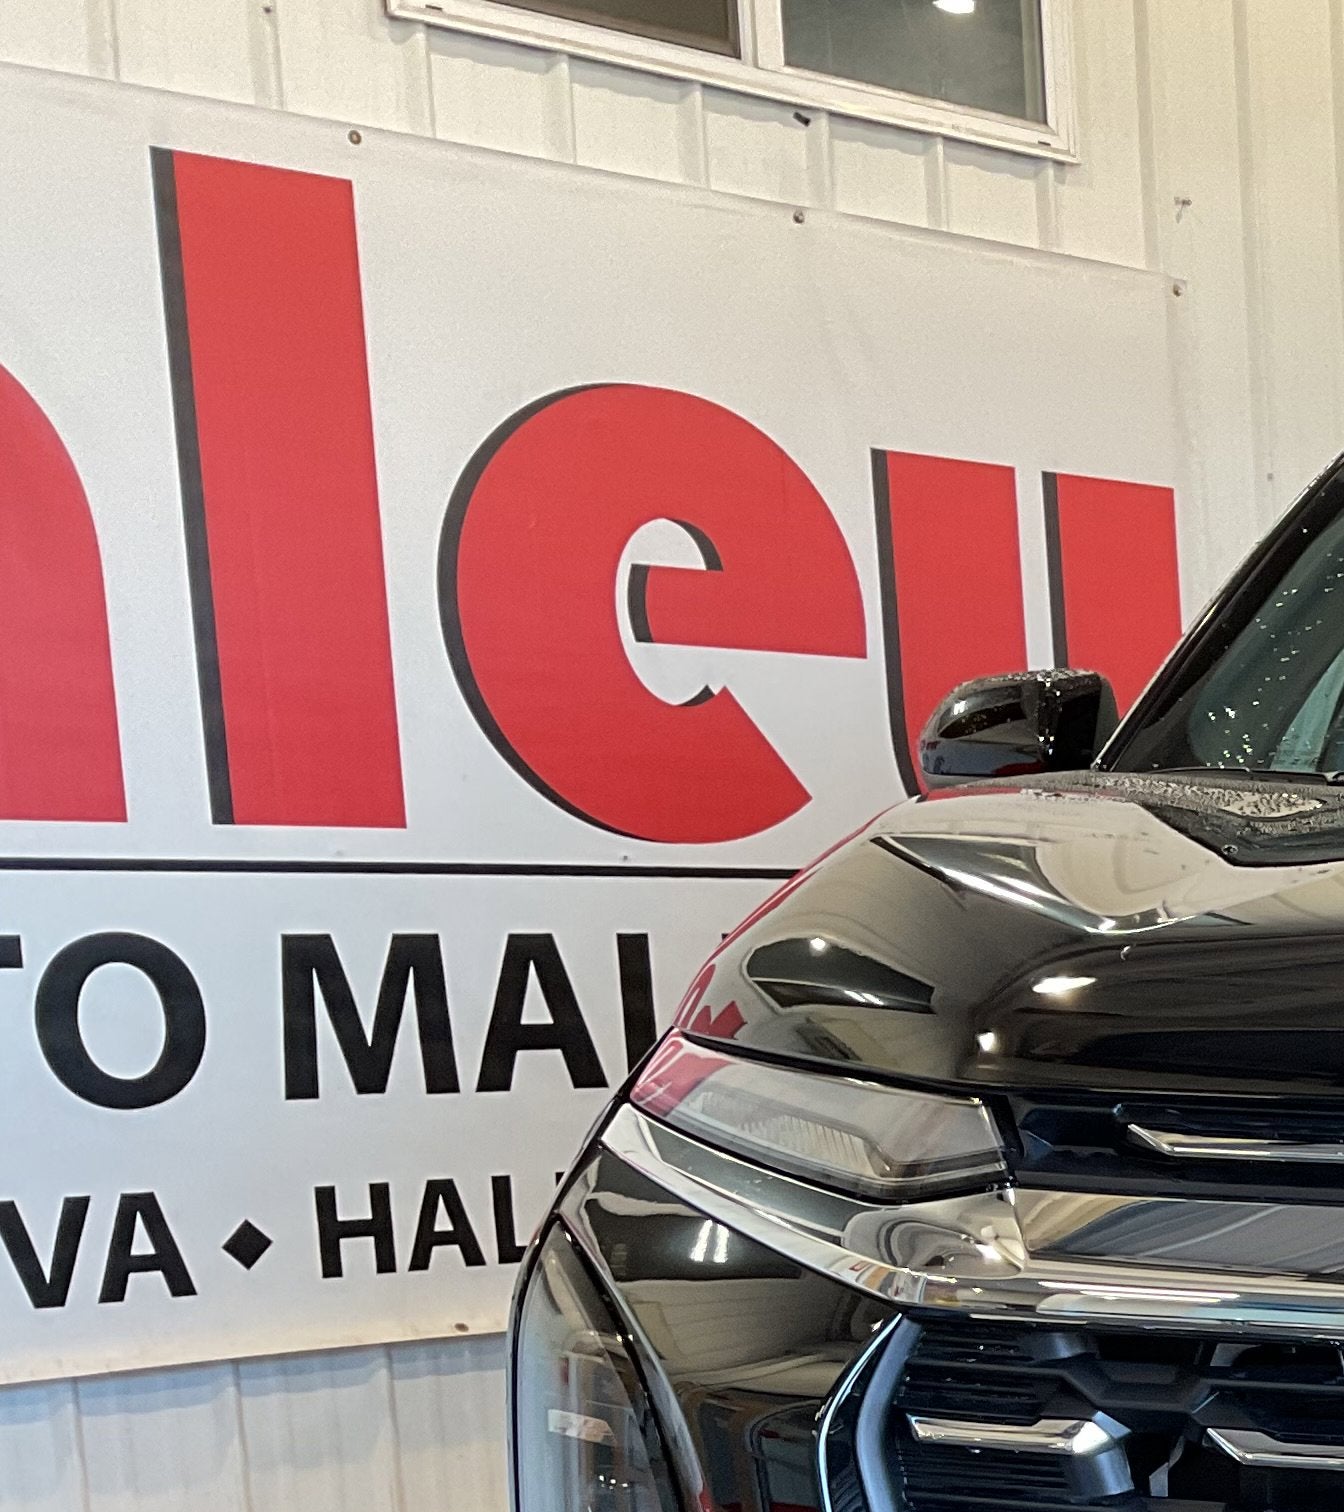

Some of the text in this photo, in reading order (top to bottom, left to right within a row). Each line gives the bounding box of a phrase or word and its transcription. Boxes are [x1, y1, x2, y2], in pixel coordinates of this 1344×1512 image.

[0, 931, 730, 1110] O MAL
[0, 1171, 567, 1309] VA HAL
